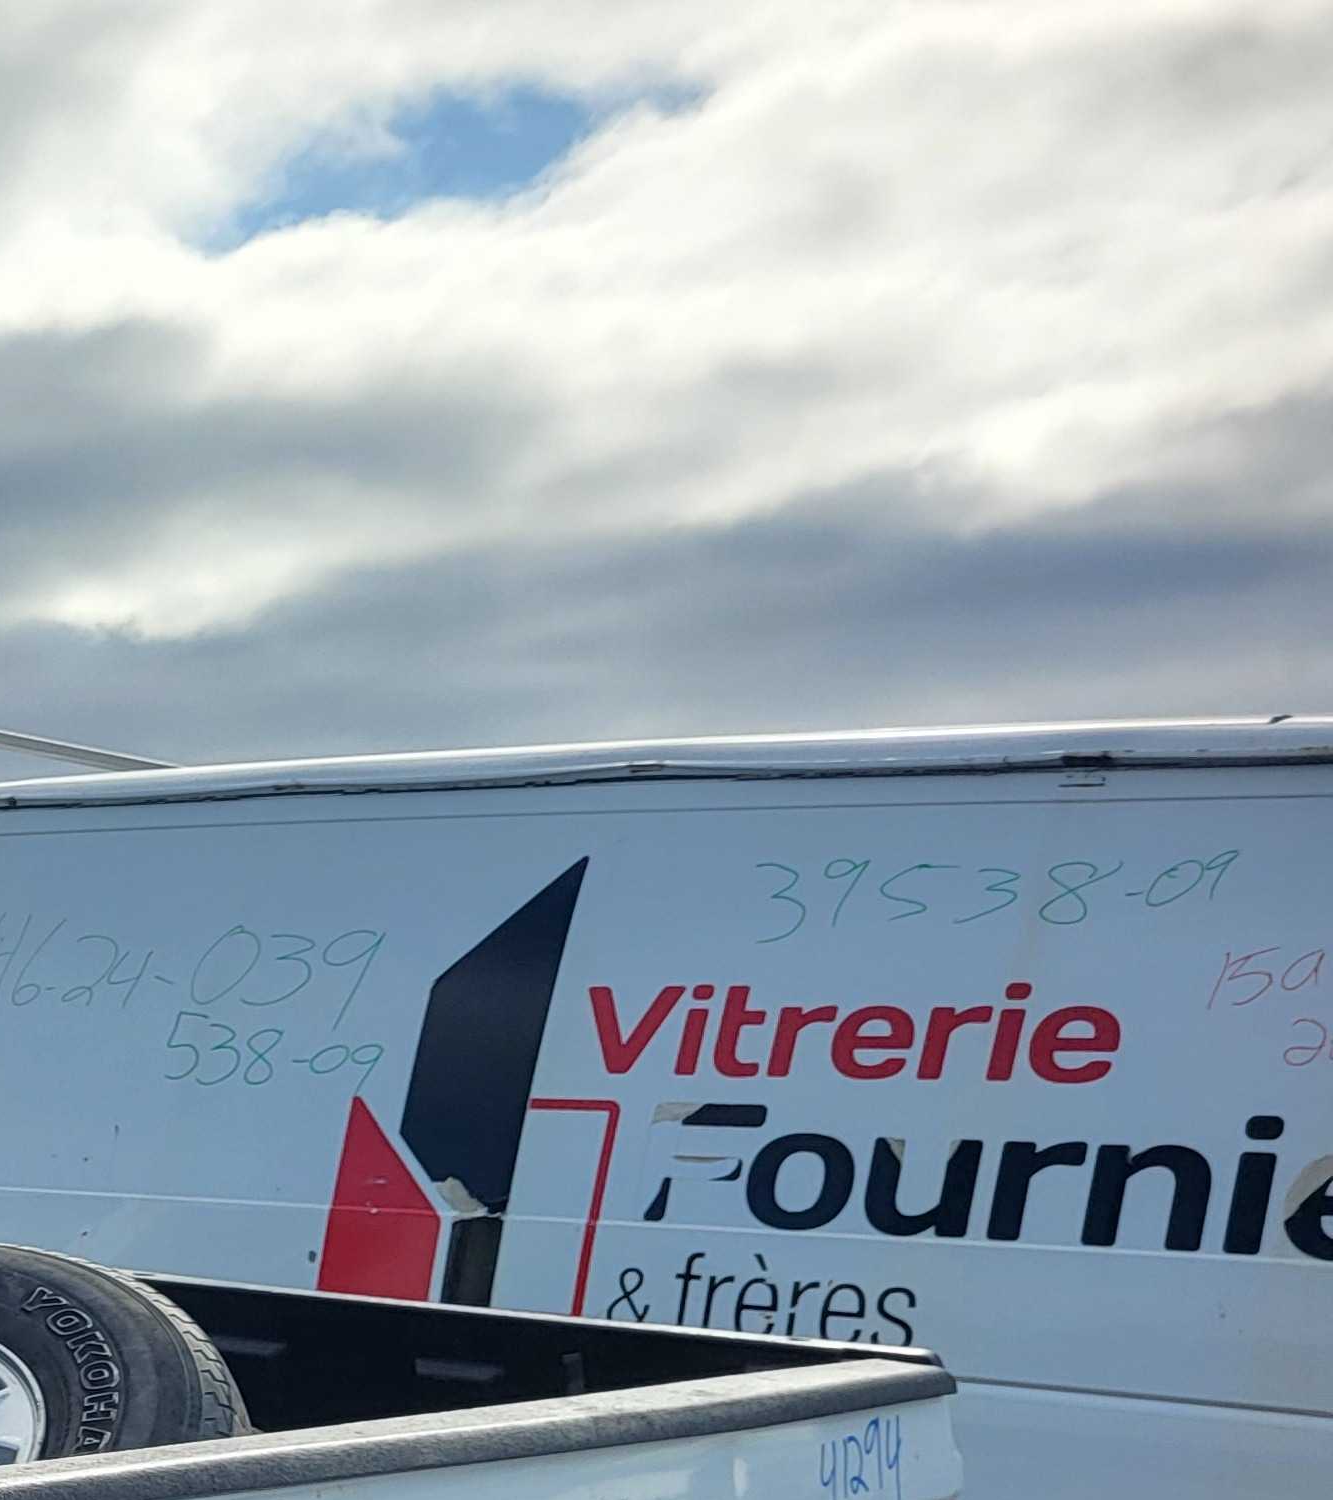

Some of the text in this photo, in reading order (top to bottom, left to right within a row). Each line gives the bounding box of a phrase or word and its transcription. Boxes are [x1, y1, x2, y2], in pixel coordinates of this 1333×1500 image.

[165, 1011, 385, 1097] 538-09
[589, 982, 1122, 1085] Vitrerie
[606, 1252, 917, 1347] & frères
